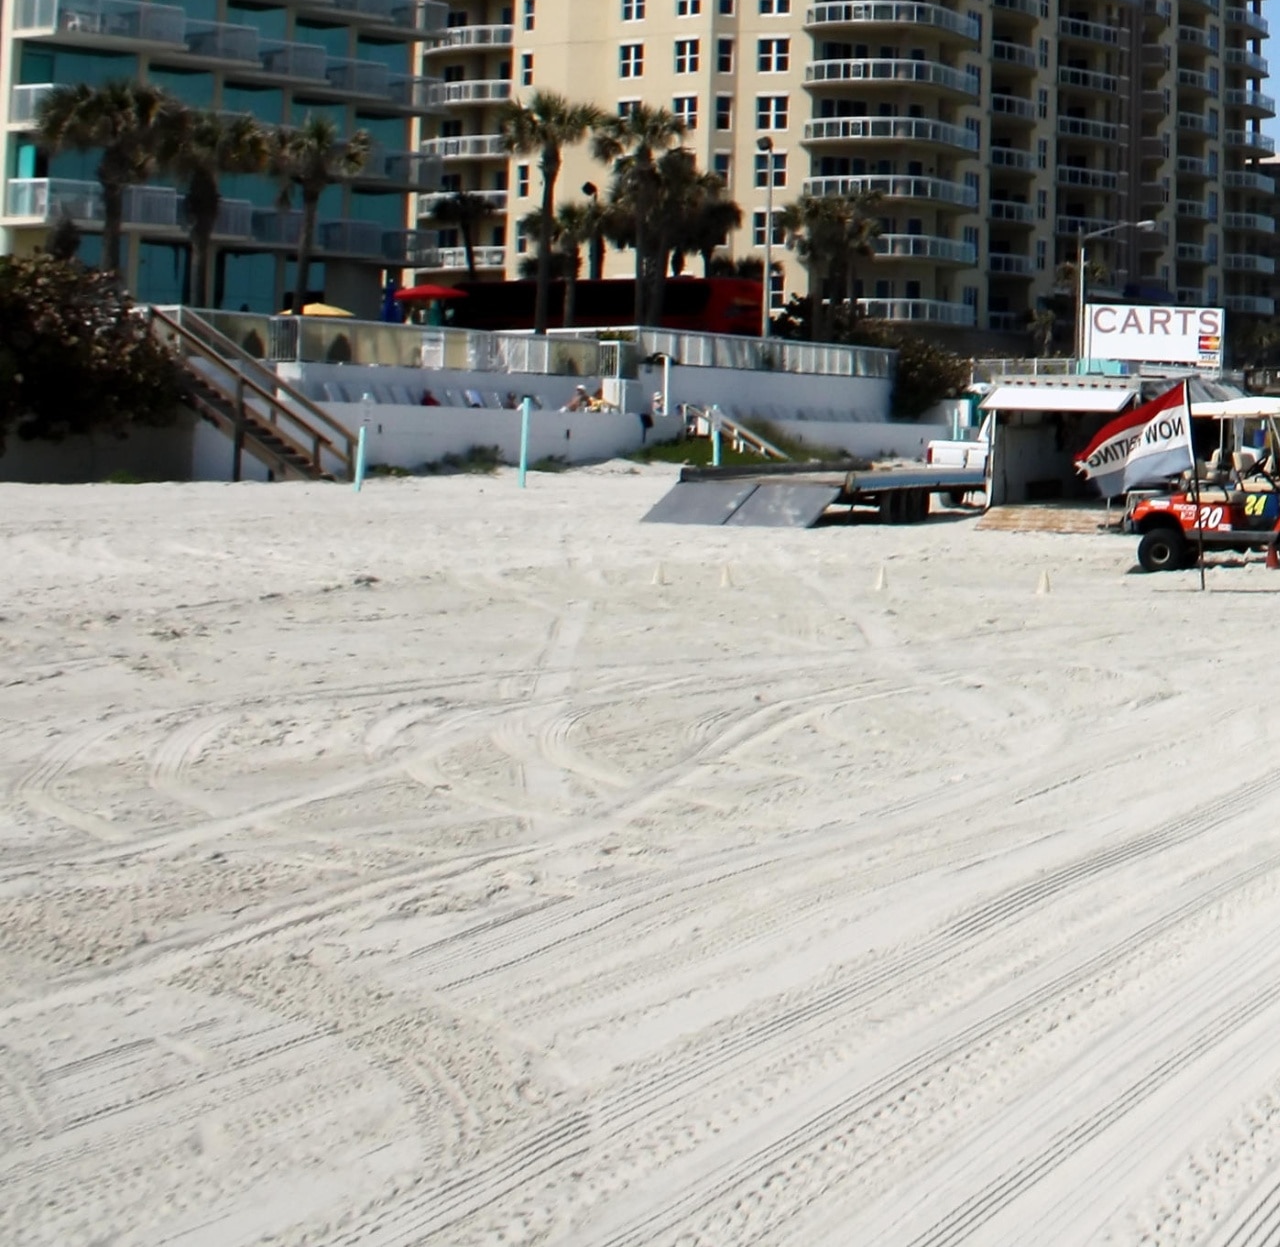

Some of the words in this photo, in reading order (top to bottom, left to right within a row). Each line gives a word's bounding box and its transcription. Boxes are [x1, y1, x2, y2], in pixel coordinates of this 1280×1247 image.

[1094, 307, 1219, 336] CARTS
[1244, 494, 1267, 515] 24
[1193, 506, 1223, 529] 20
